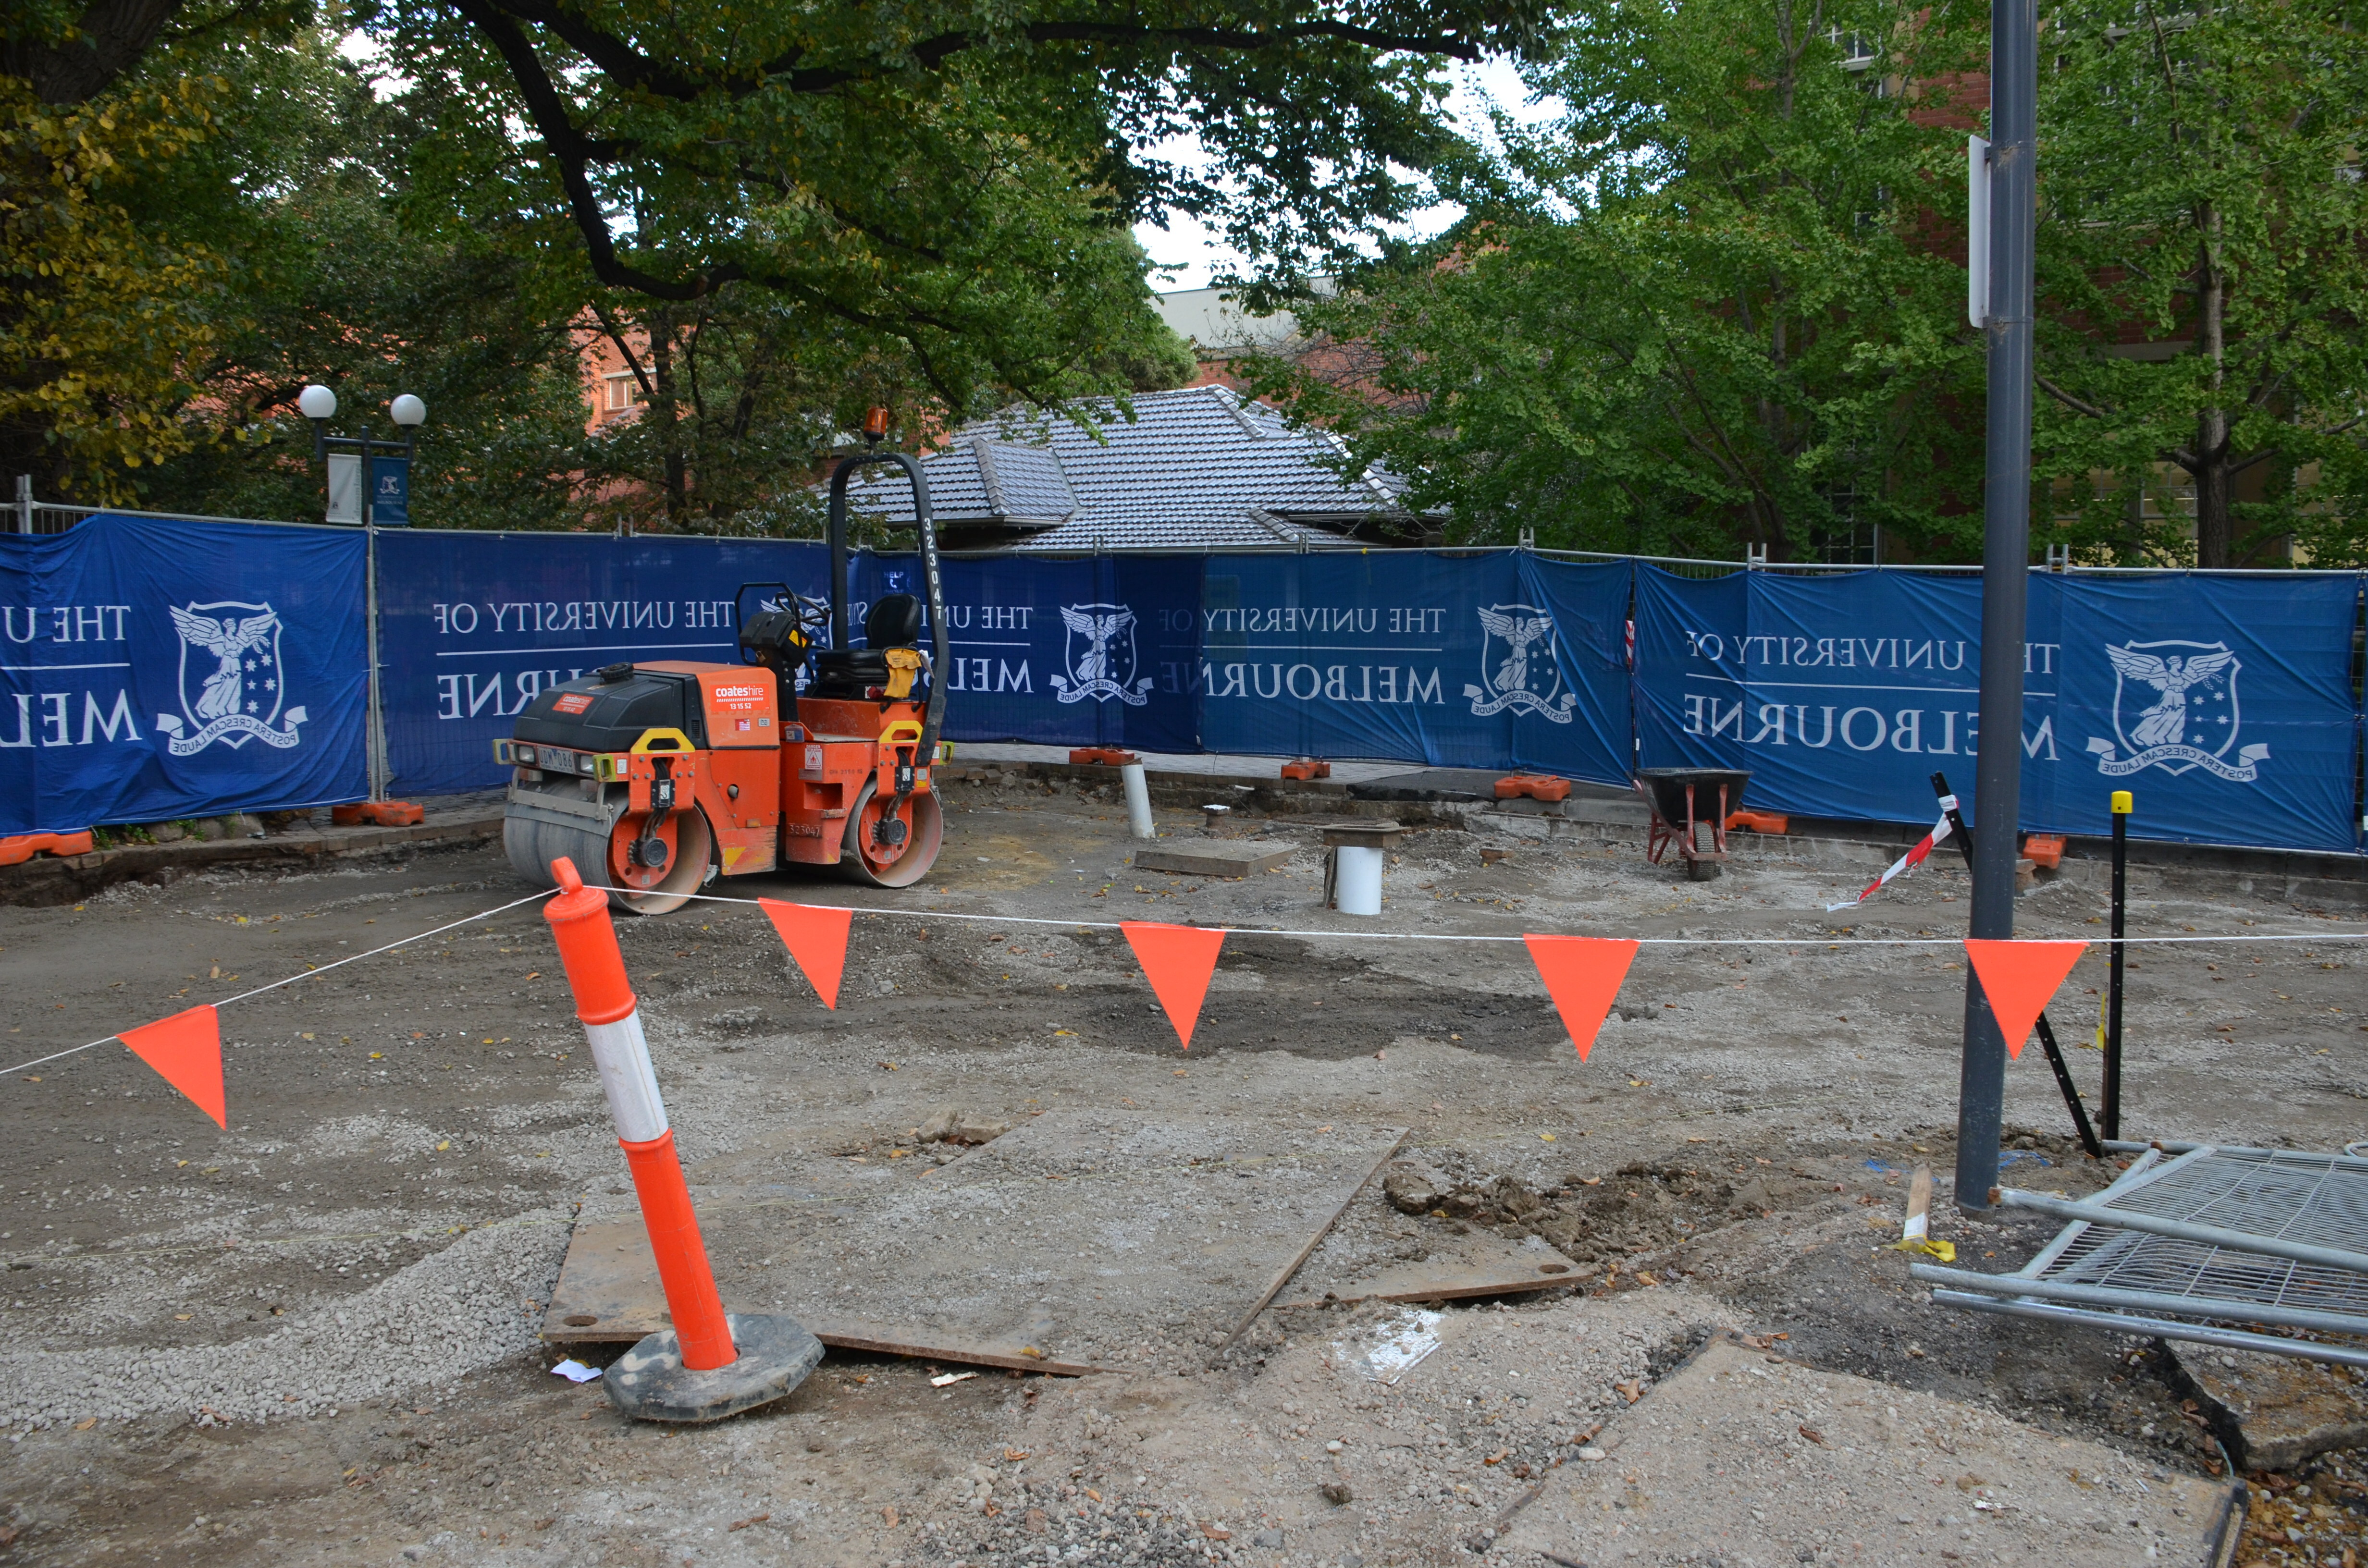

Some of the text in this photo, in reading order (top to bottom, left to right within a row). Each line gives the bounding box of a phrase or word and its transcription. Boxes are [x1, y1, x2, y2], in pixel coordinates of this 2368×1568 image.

[924, 517, 942, 620] 323047
[558, 753, 573, 768] 086
[789, 824, 820, 837] 323047
